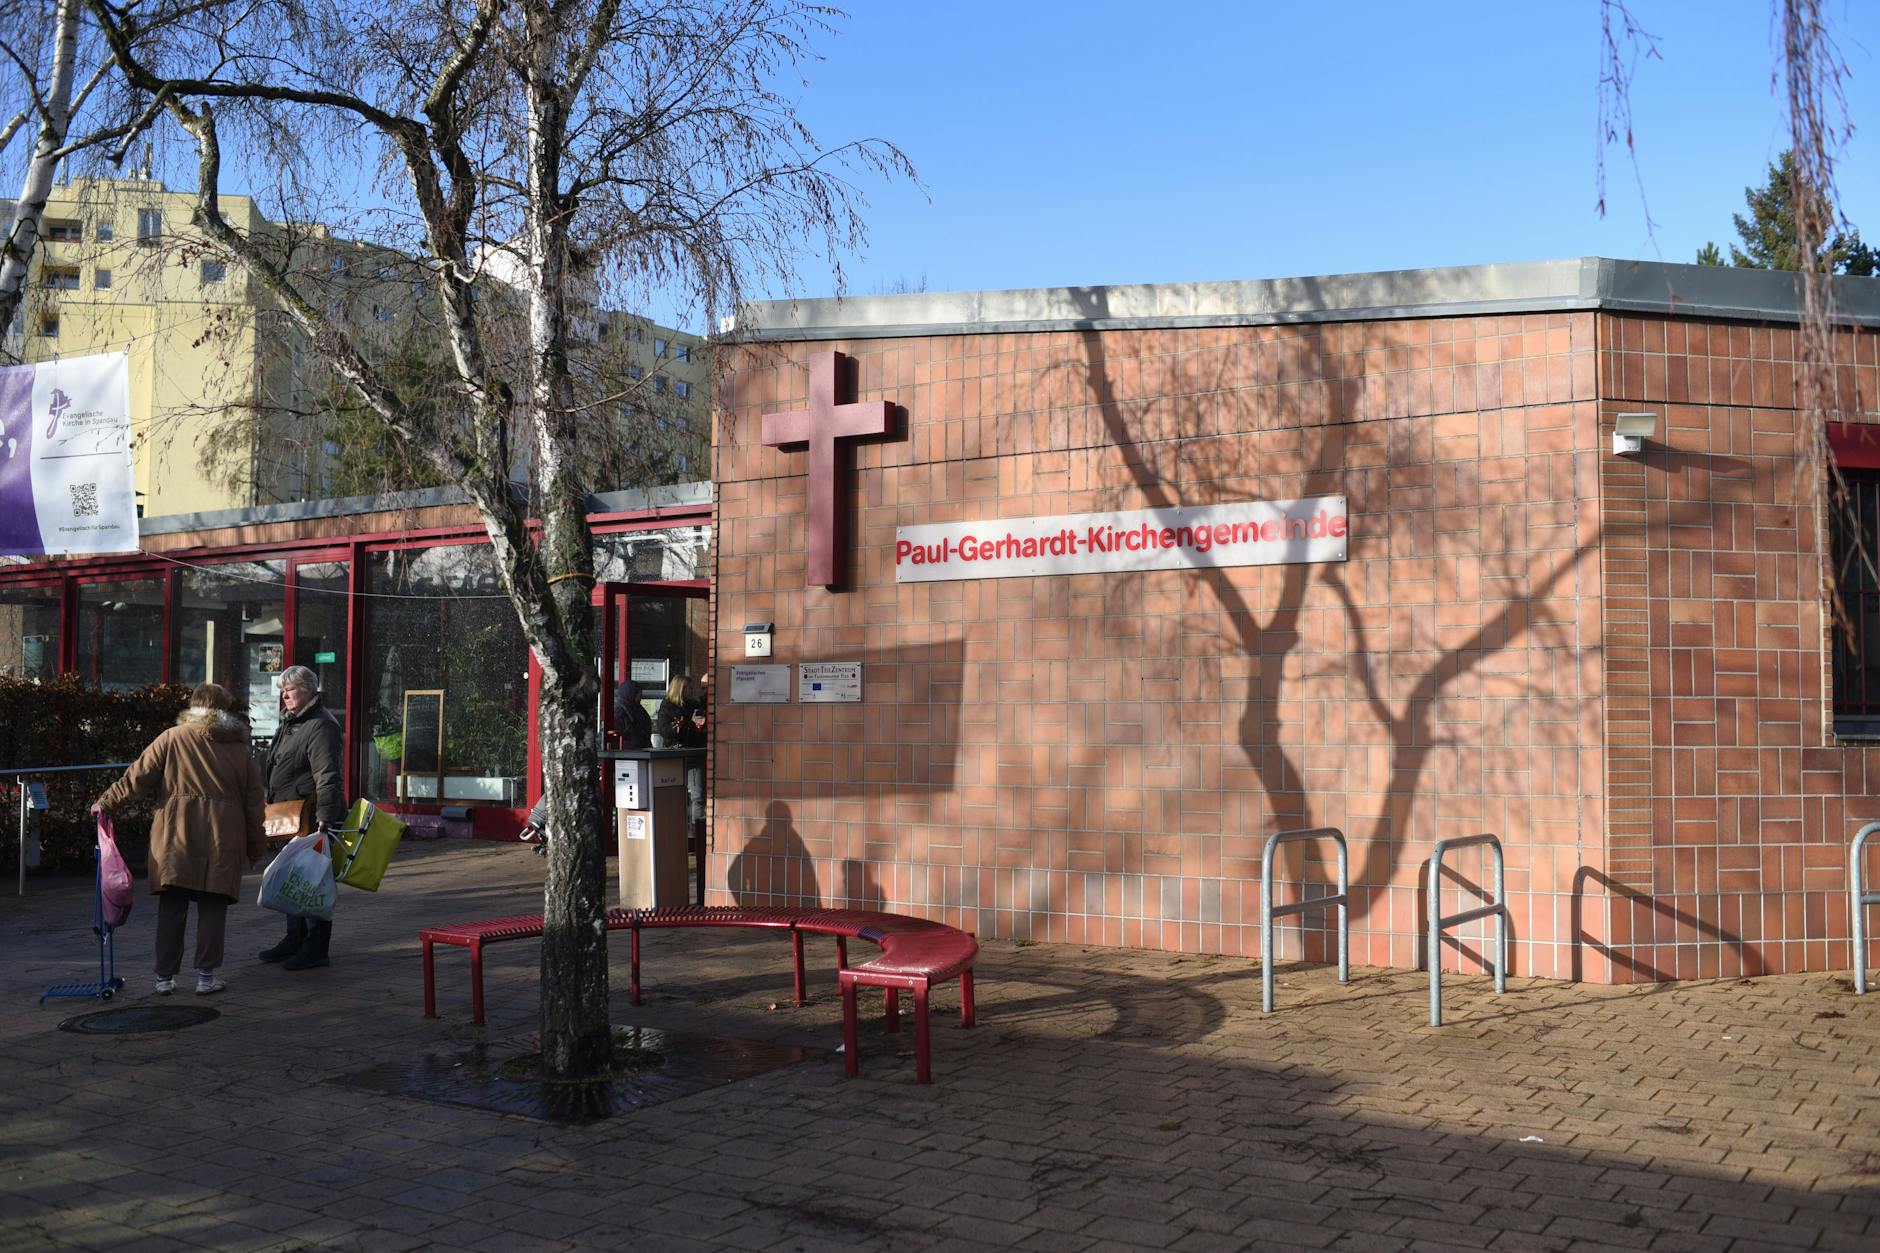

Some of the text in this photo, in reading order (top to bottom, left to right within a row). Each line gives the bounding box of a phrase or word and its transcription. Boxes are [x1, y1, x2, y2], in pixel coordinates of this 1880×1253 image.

[62, 410, 103, 419] Evangelische
[62, 417, 118, 428] Kirche in Spandau
[896, 509, 1347, 566] Paul-Gerhardt-Kirchengemeinde
[751, 638, 763, 649] 26
